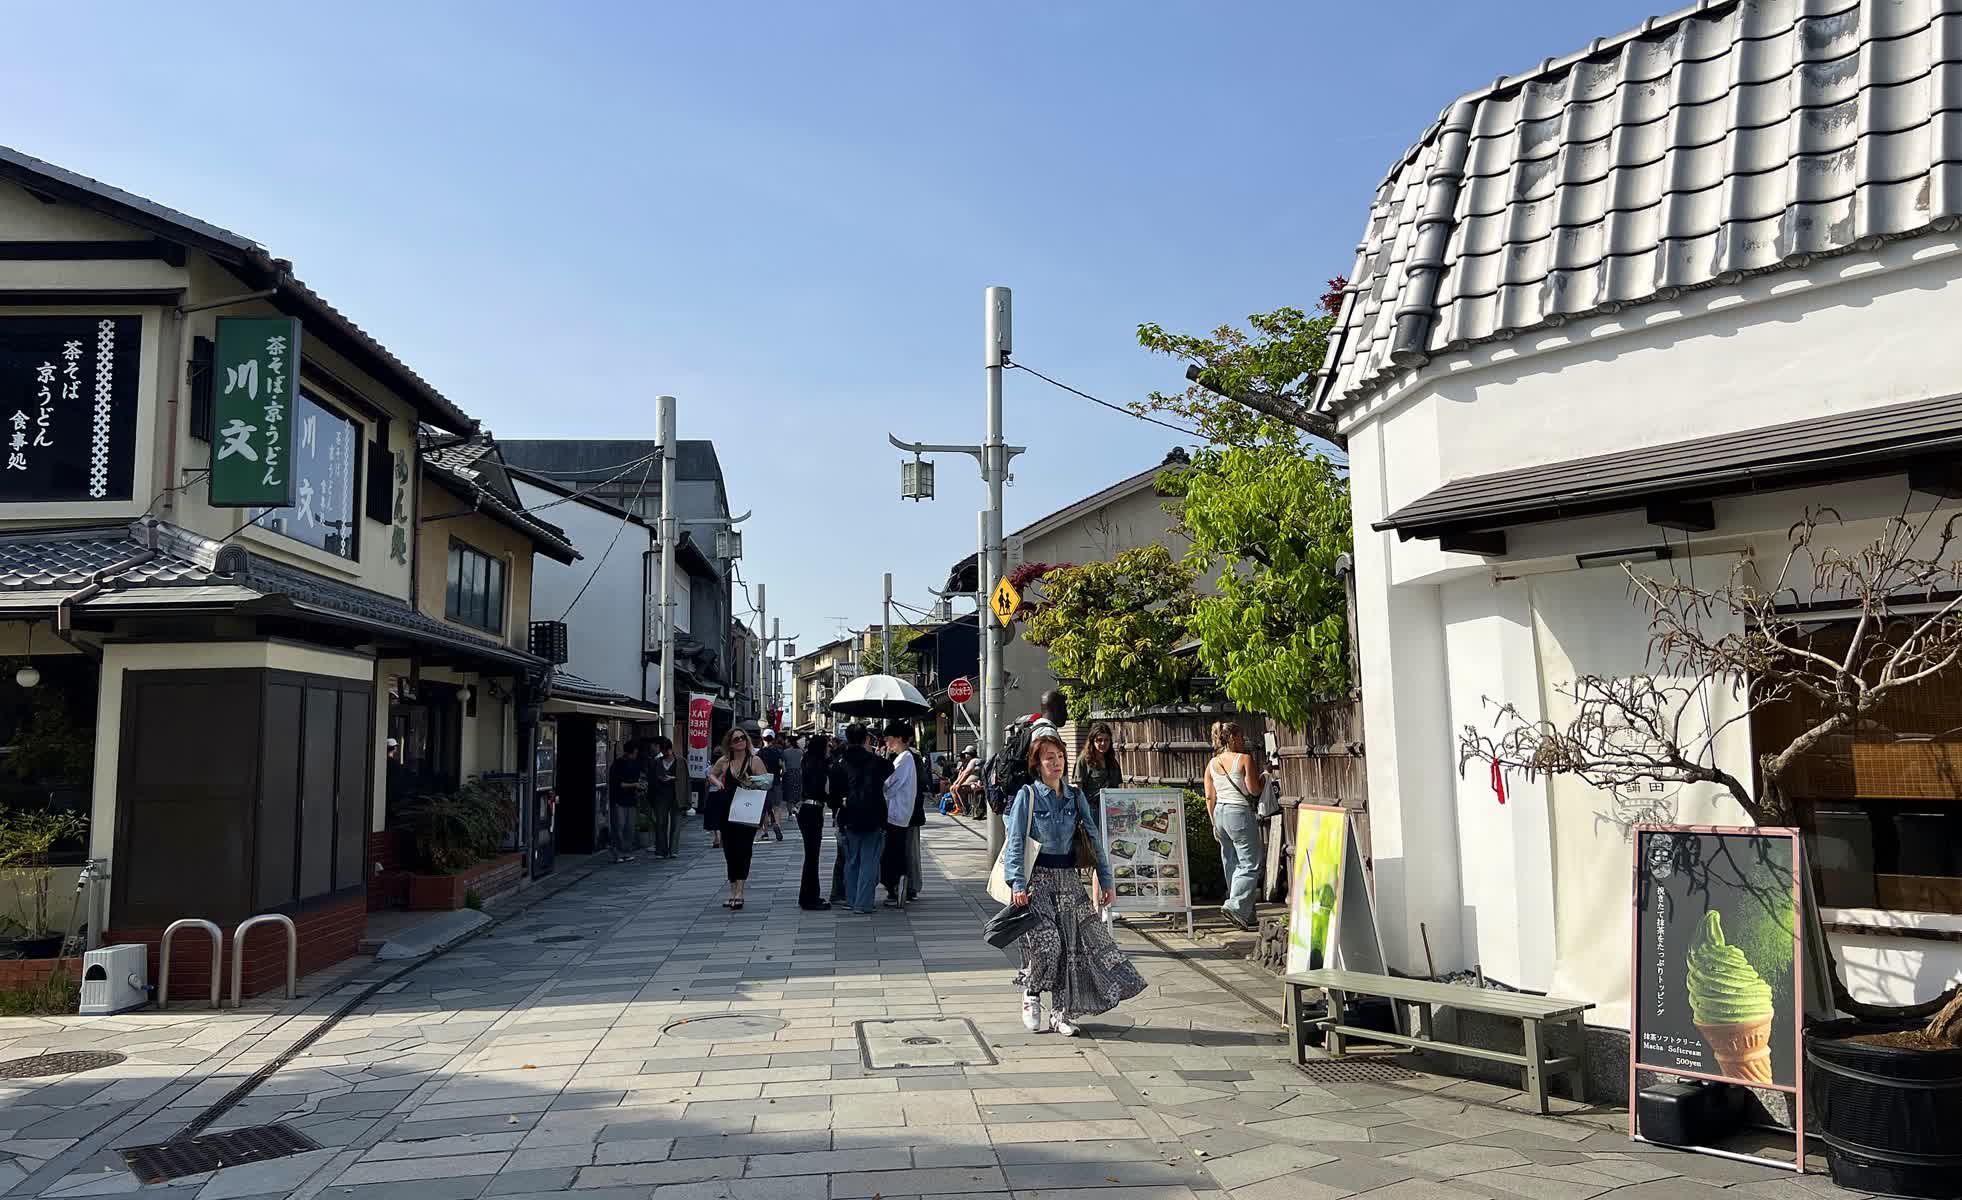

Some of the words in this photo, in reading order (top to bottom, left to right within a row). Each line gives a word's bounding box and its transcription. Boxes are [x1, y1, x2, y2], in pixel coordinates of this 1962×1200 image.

[62, 340, 83, 399] 茶そば
[33, 361, 57, 447] 京うどん
[217, 359, 258, 462] 川文
[7, 409, 30, 470] 食事処
[298, 415, 317, 528] 川文
[1643, 1032, 1702, 1047] 抹茶ソフトクリーム
[1667, 1045, 1702, 1057] Softcream
[1675, 1057, 1702, 1068] 500yen
